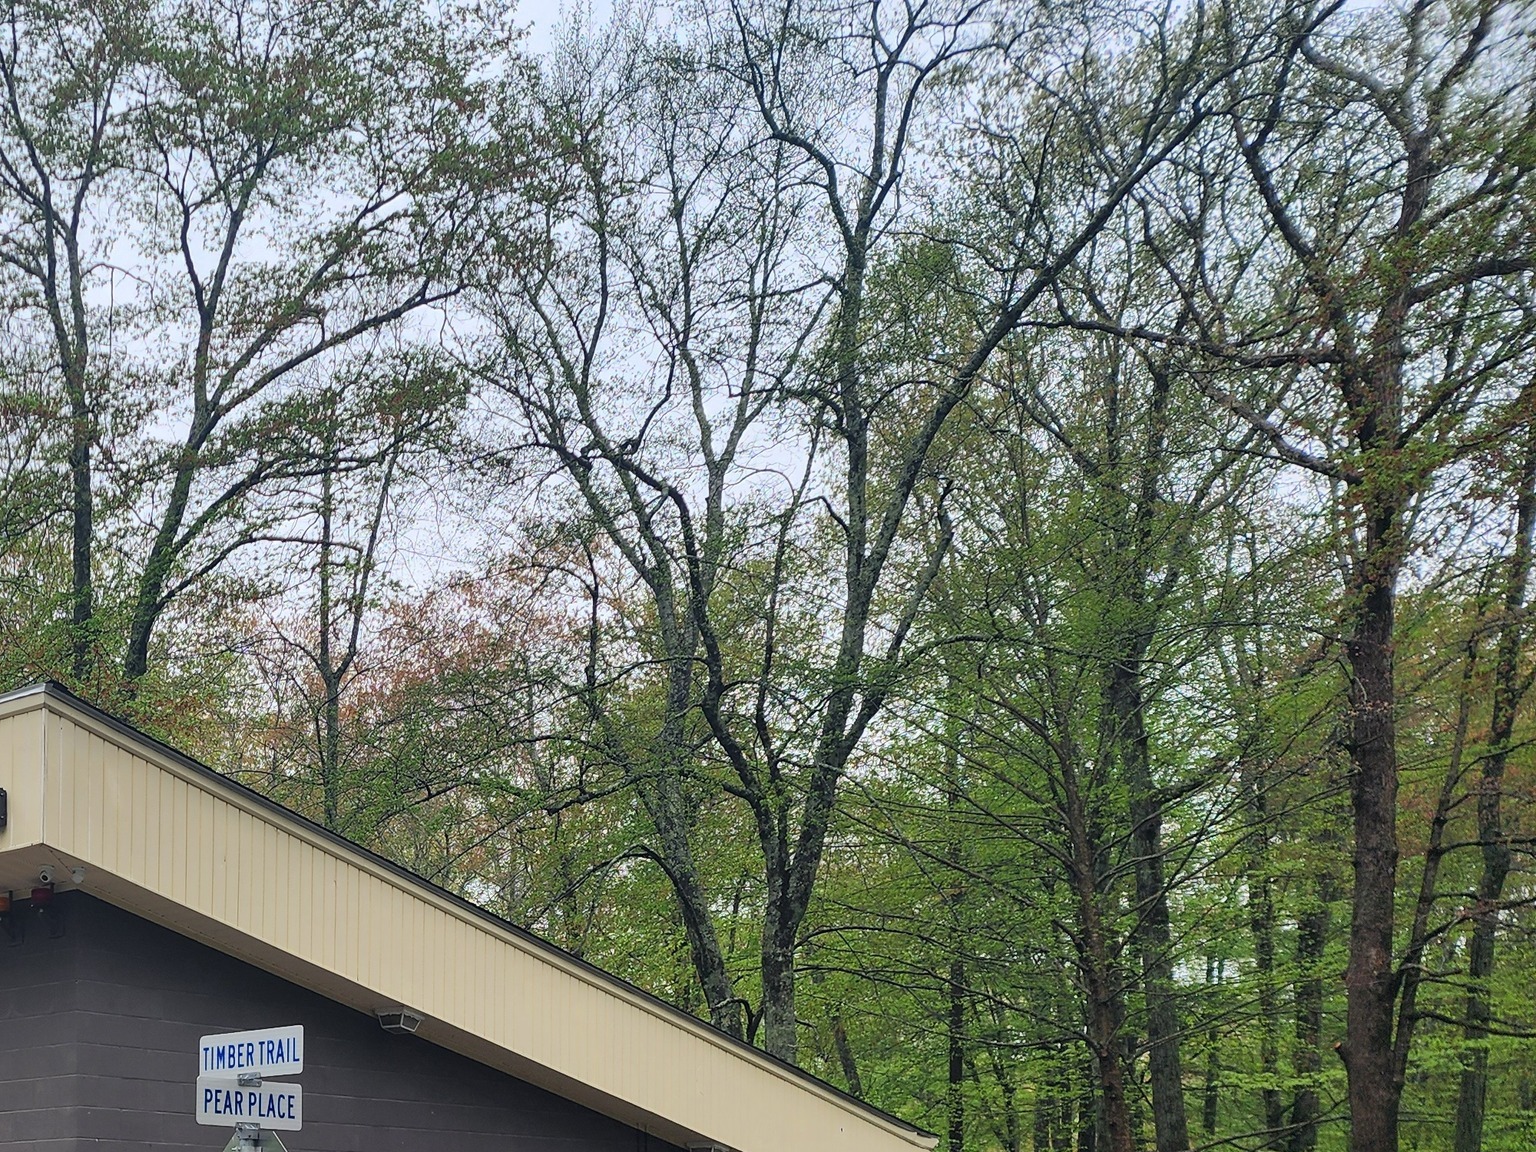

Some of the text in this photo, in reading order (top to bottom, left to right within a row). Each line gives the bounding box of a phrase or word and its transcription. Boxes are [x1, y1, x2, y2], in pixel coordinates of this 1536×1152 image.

[203, 1037, 300, 1071] TIMBER TRAIL
[204, 1088, 296, 1119] PEAR PLACE
